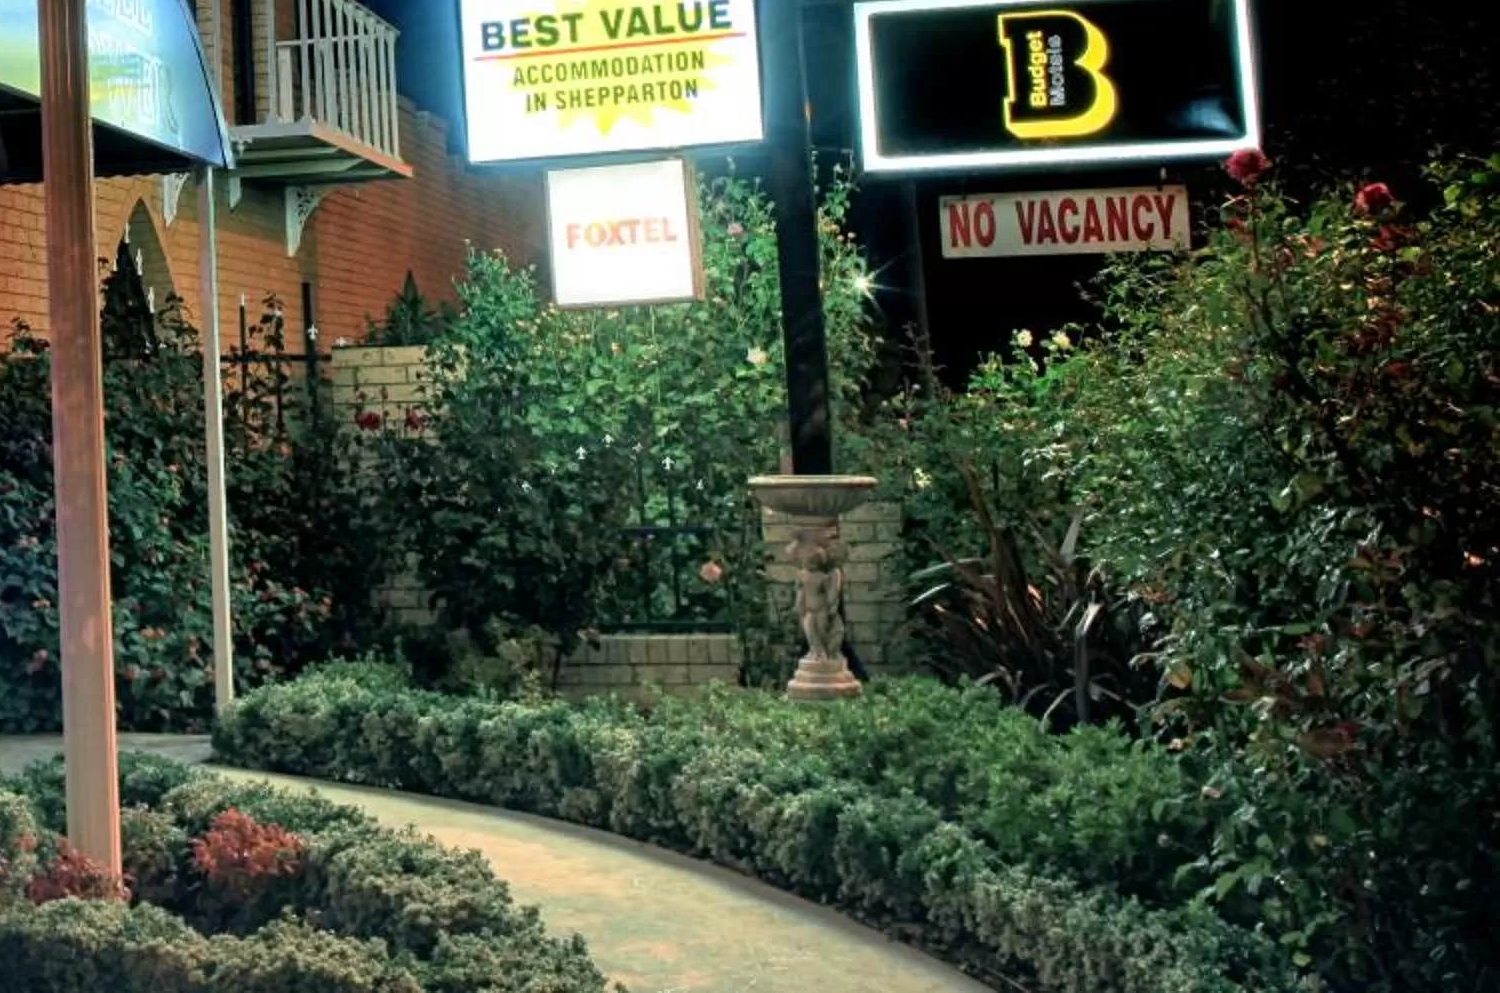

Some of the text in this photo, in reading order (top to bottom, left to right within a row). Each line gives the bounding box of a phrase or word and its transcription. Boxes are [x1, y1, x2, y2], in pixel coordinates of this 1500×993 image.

[480, 12, 585, 52] BEST
[512, 49, 705, 87] ACCOMMODATION
[1026, 30, 1048, 107] Budget
[1046, 34, 1066, 106] Motels
[526, 78, 699, 113] IN SHEPPARTON
[566, 216, 678, 250] FOXTEL
[948, 194, 1177, 249] NO VACANCY
